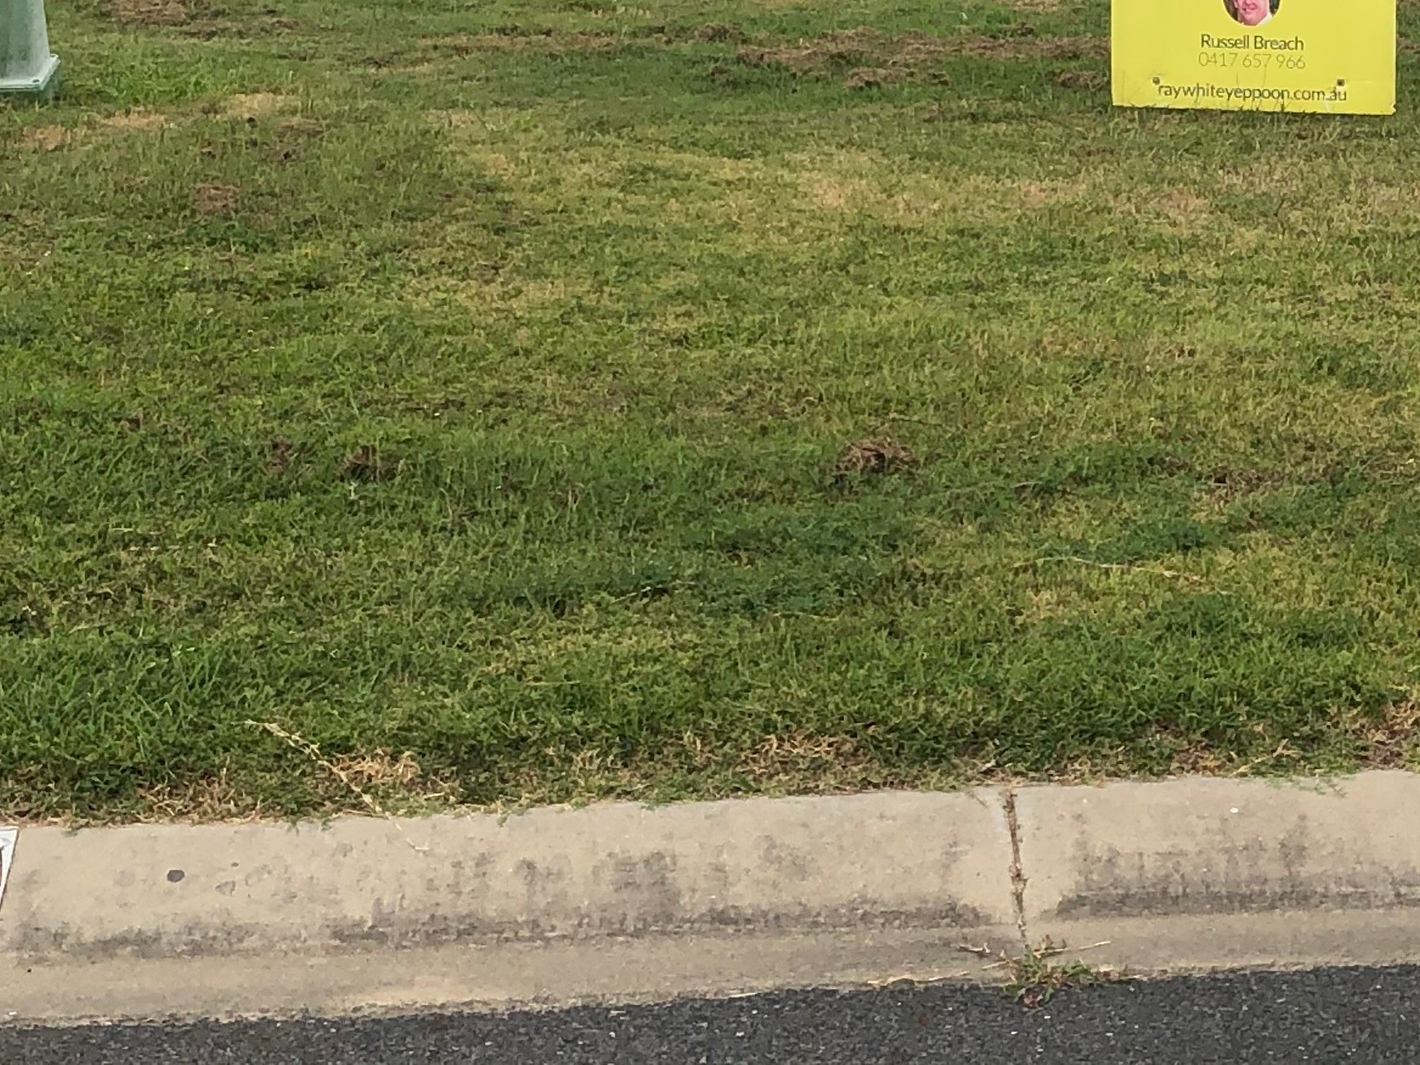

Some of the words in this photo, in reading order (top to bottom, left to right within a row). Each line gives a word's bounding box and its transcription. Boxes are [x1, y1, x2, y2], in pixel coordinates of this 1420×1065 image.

[1201, 34, 1249, 50] Russell
[1254, 35, 1304, 51] Breach
[1199, 51, 1238, 67] 0417
[1243, 52, 1272, 68] 657
[1276, 53, 1306, 70] 966
[1158, 81, 1347, 102] raywhiteyeppoon.com.au
